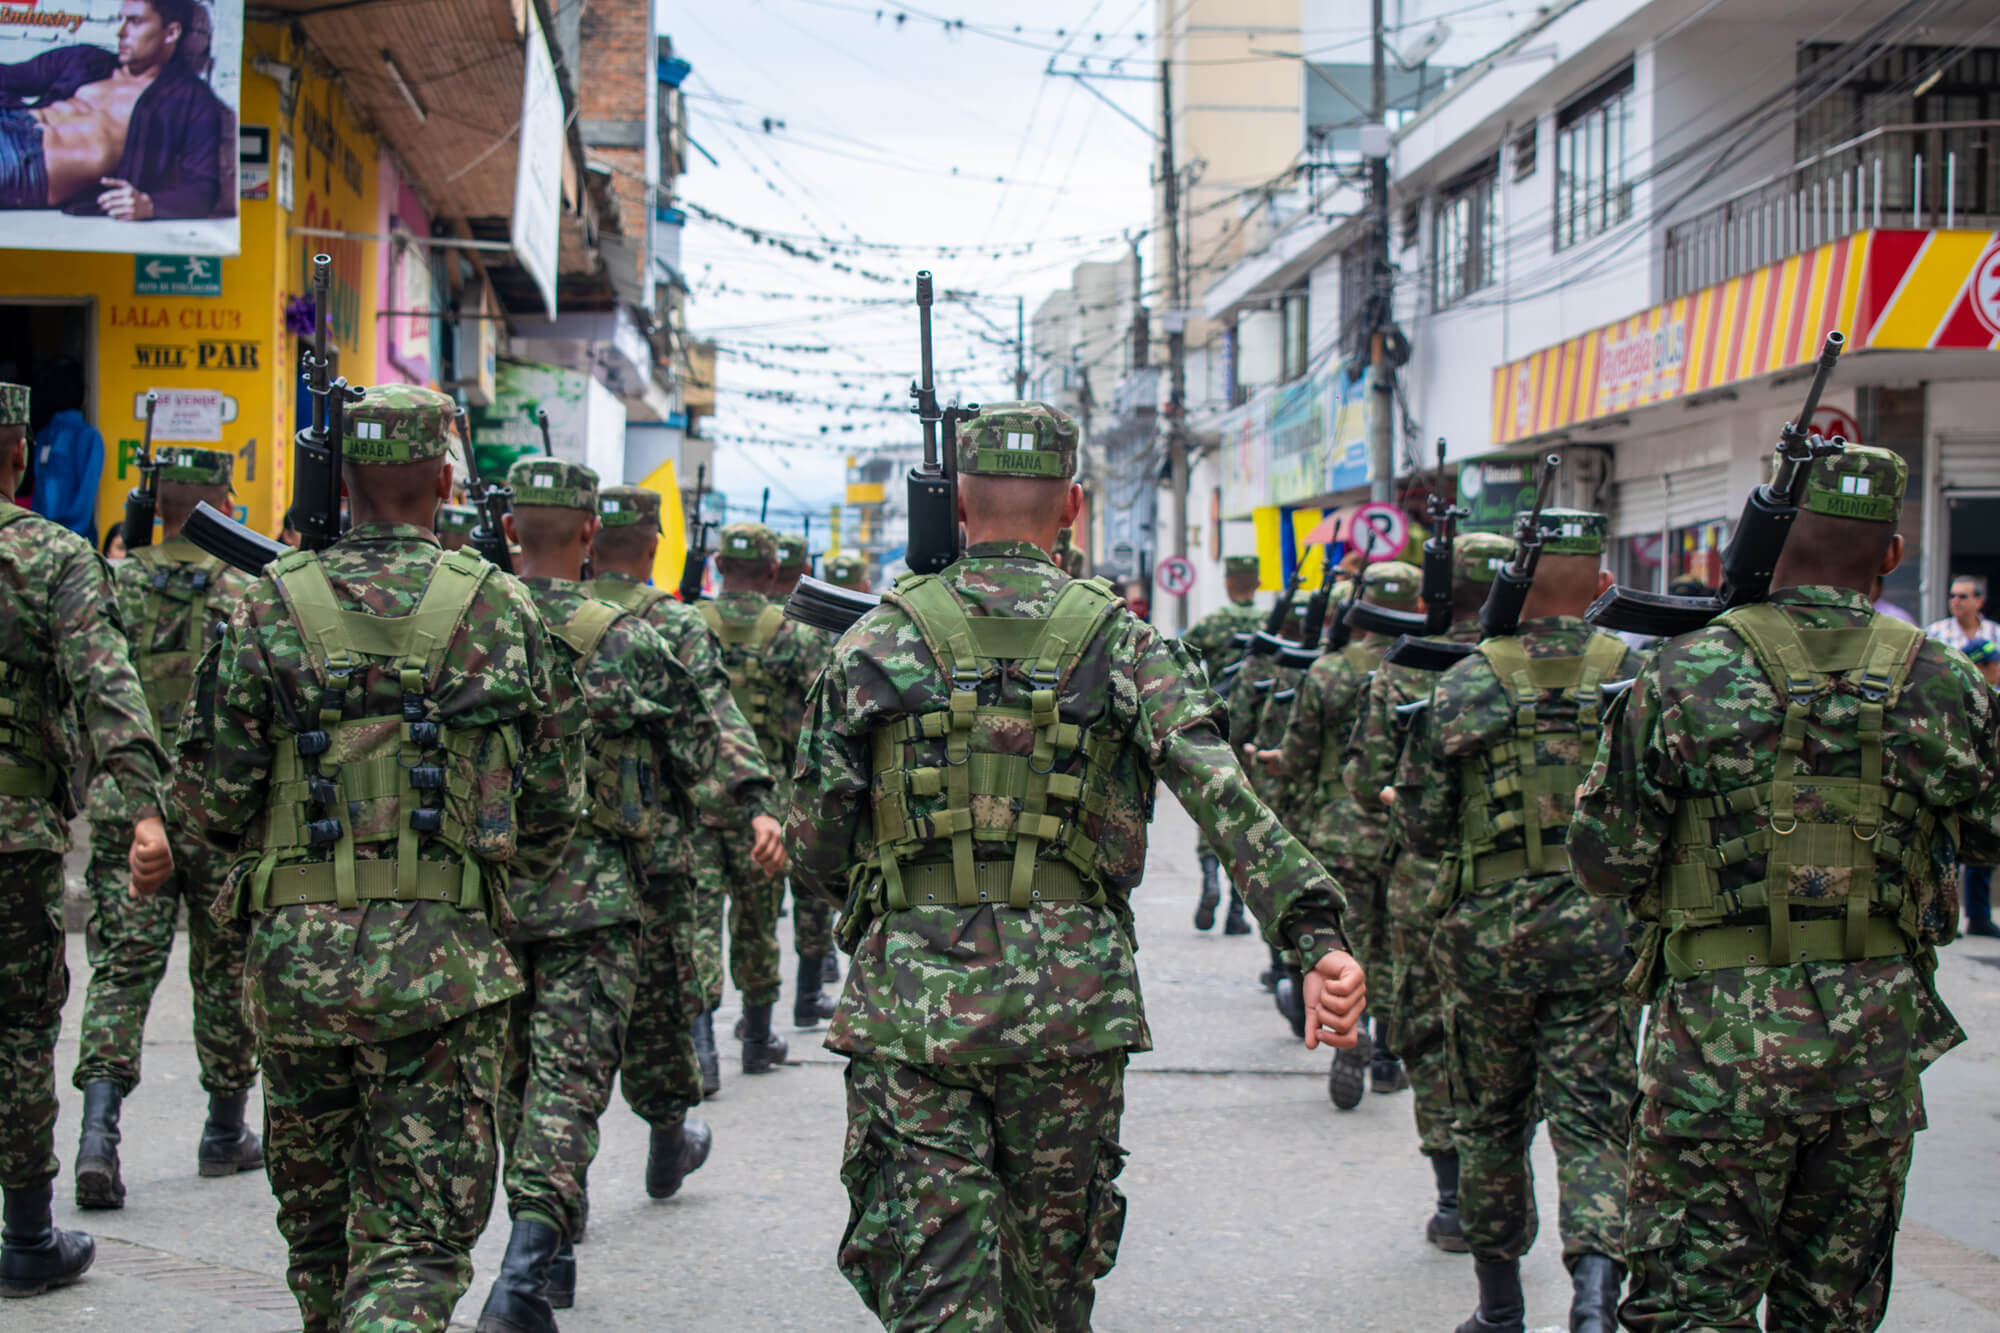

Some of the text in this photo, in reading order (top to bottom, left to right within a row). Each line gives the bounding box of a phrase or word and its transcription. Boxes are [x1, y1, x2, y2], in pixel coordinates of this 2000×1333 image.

[0, 7, 83, 33] Industry
[110, 306, 170, 328] LALA
[348, 441, 393, 457] JARABA
[995, 453, 1042, 470] TRIANA
